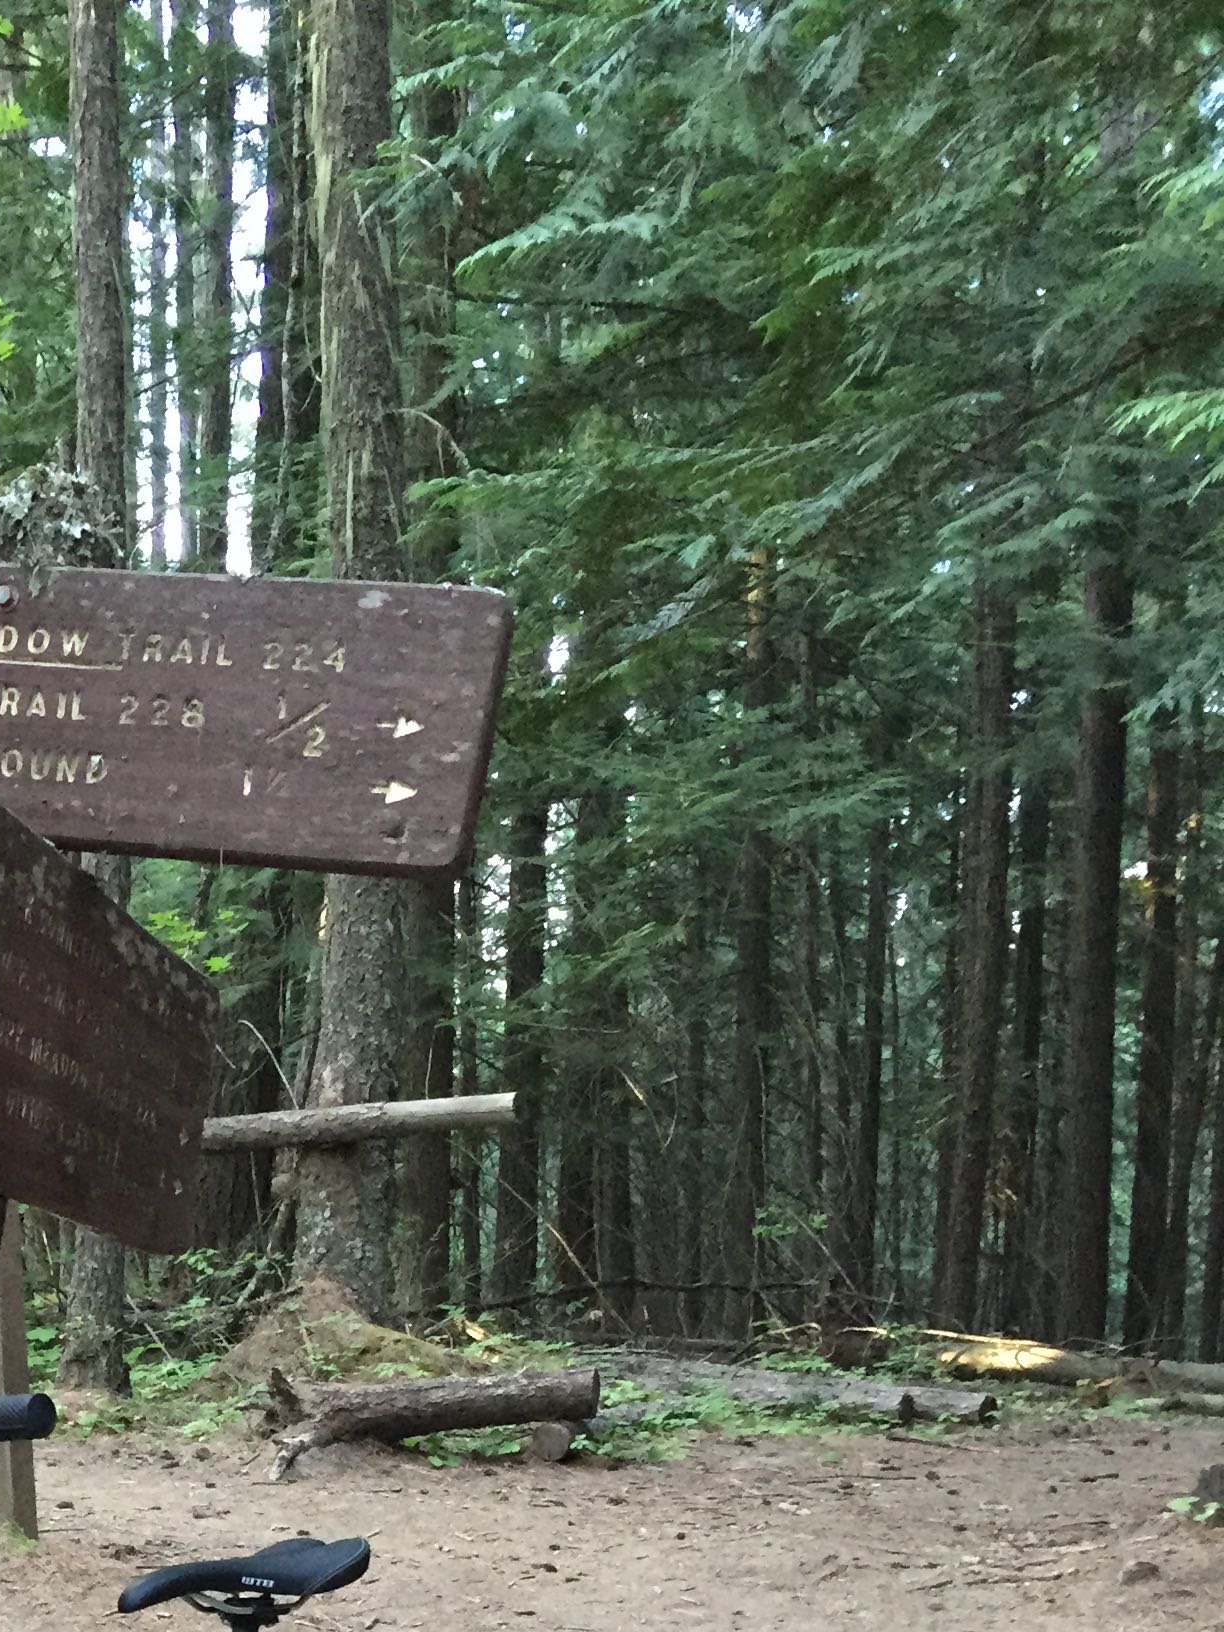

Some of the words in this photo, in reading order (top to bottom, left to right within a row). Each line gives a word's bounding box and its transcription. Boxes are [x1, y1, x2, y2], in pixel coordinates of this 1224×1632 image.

[117, 633, 233, 667] TRAIL
[262, 641, 347, 673] 224
[118, 694, 206, 729] 228
